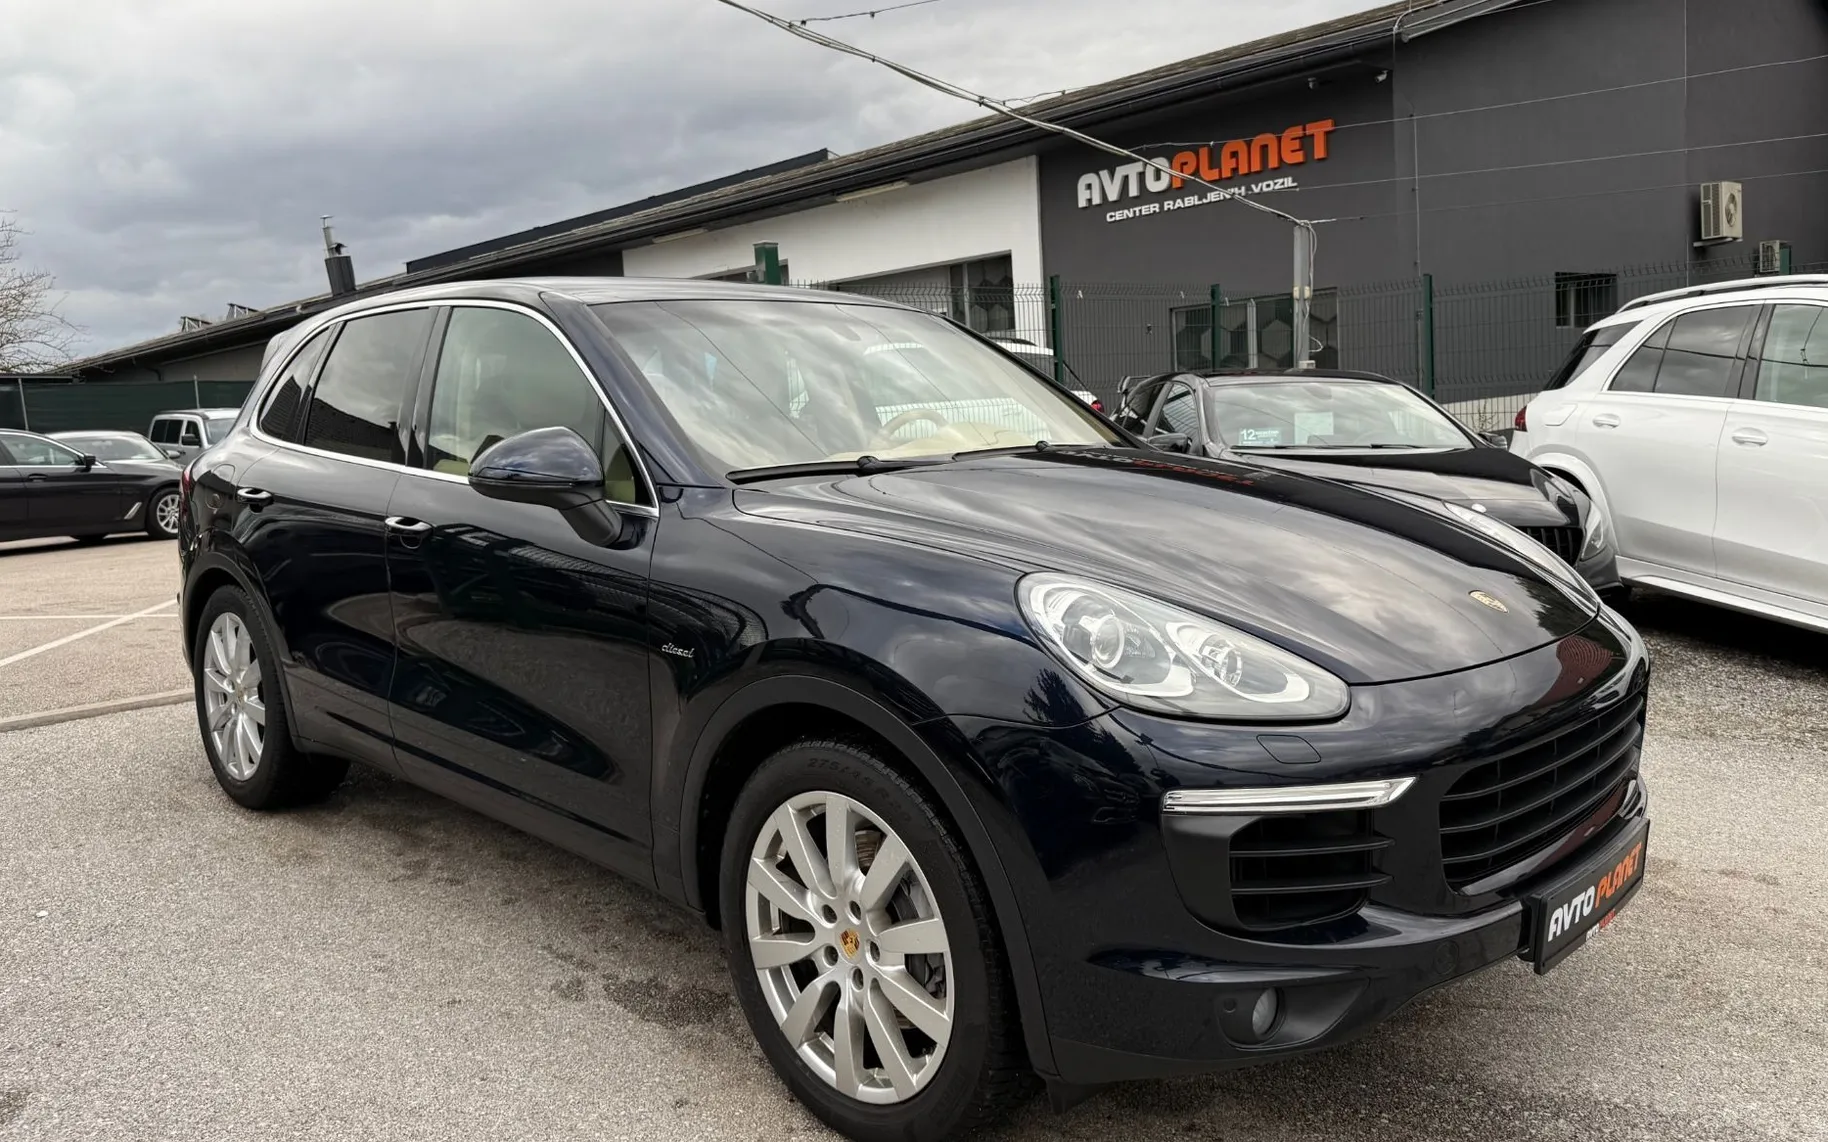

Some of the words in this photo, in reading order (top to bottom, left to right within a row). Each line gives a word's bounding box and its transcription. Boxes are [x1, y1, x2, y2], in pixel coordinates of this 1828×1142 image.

[1106, 203, 1160, 223] CENTER
[1250, 176, 1298, 194] VOZIL
[1240, 428, 1257, 441] 12
[661, 642, 695, 658] diesel
[1547, 885, 1596, 943] AVTO
[1595, 842, 1643, 909] PLANET
